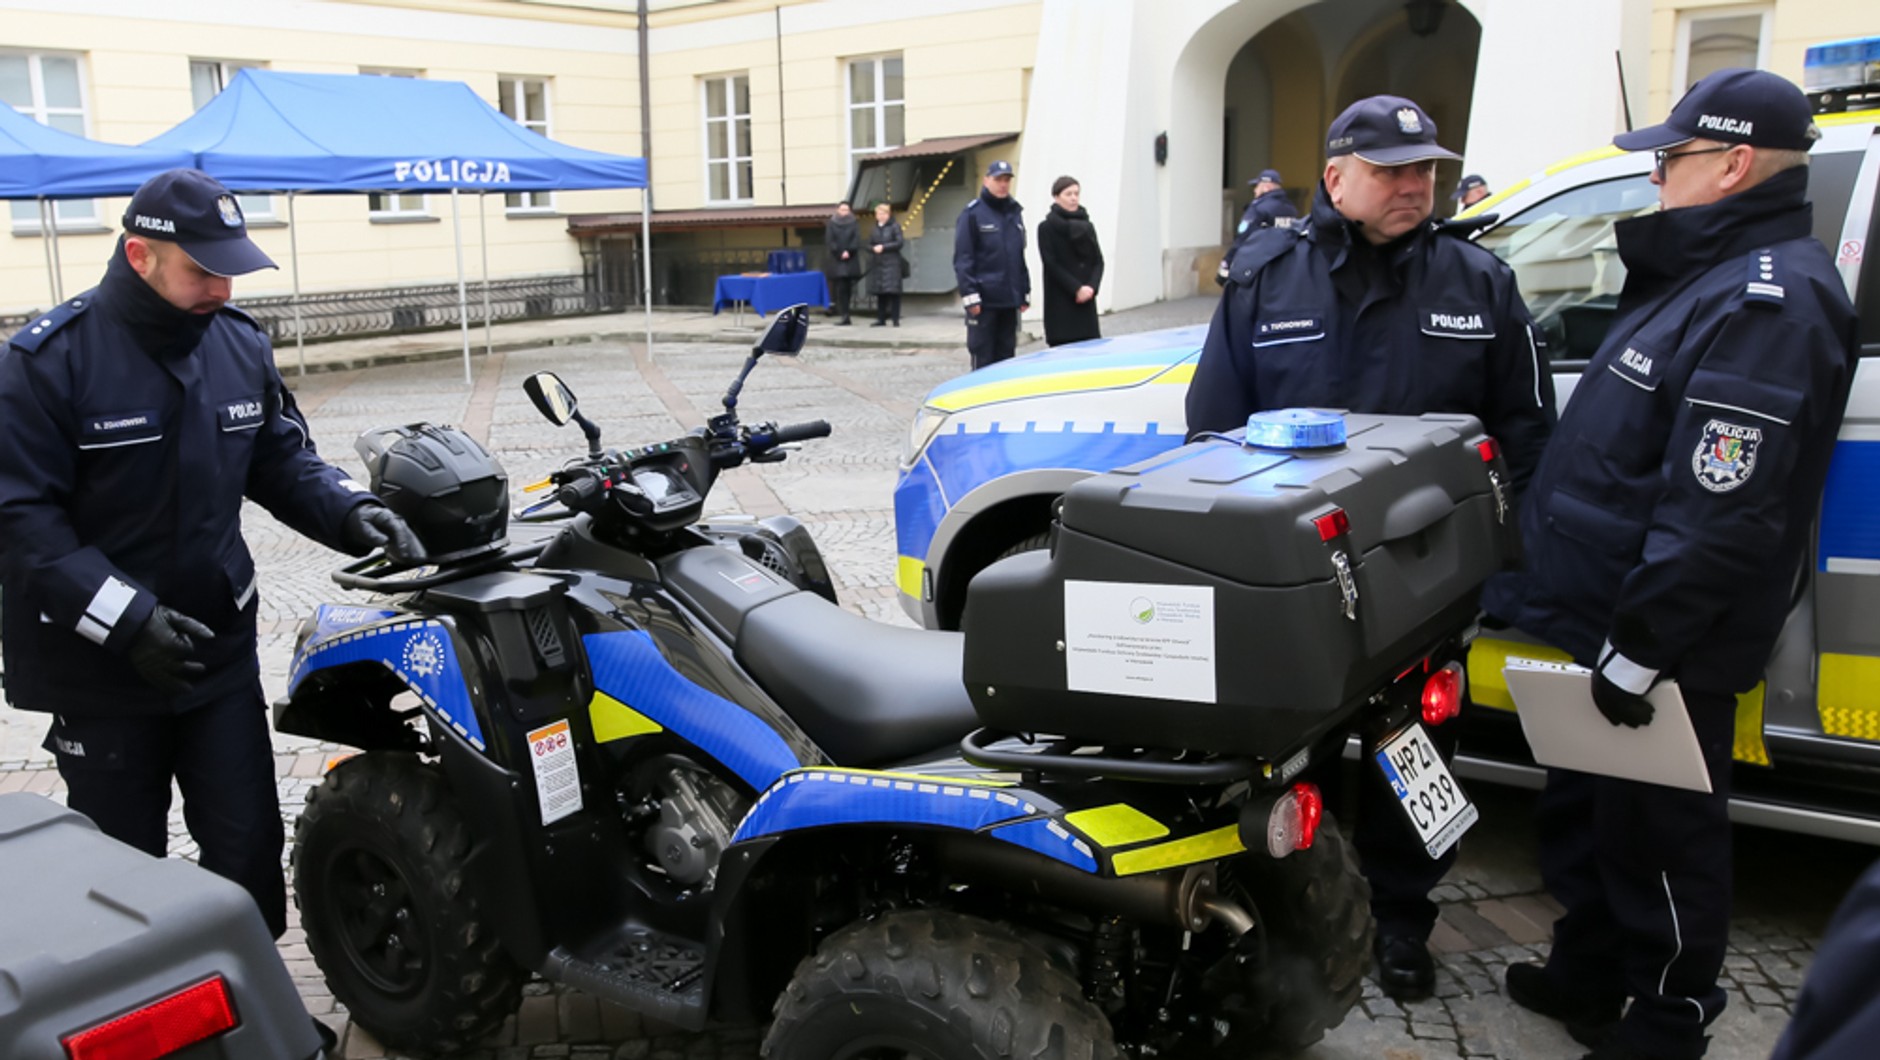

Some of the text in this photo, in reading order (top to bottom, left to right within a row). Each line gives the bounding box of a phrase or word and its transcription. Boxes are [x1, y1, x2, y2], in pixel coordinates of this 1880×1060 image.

[1697, 114, 1754, 136] POLICJA
[394, 159, 511, 183] POLICJA
[134, 214, 176, 233] POLICJA
[1430, 313, 1484, 329] POLICJA
[1618, 347, 1653, 376] POLICJA
[1708, 422, 1758, 441] POLICJA
[1391, 737, 1431, 785] HPZ
[1409, 773, 1456, 830] C939
